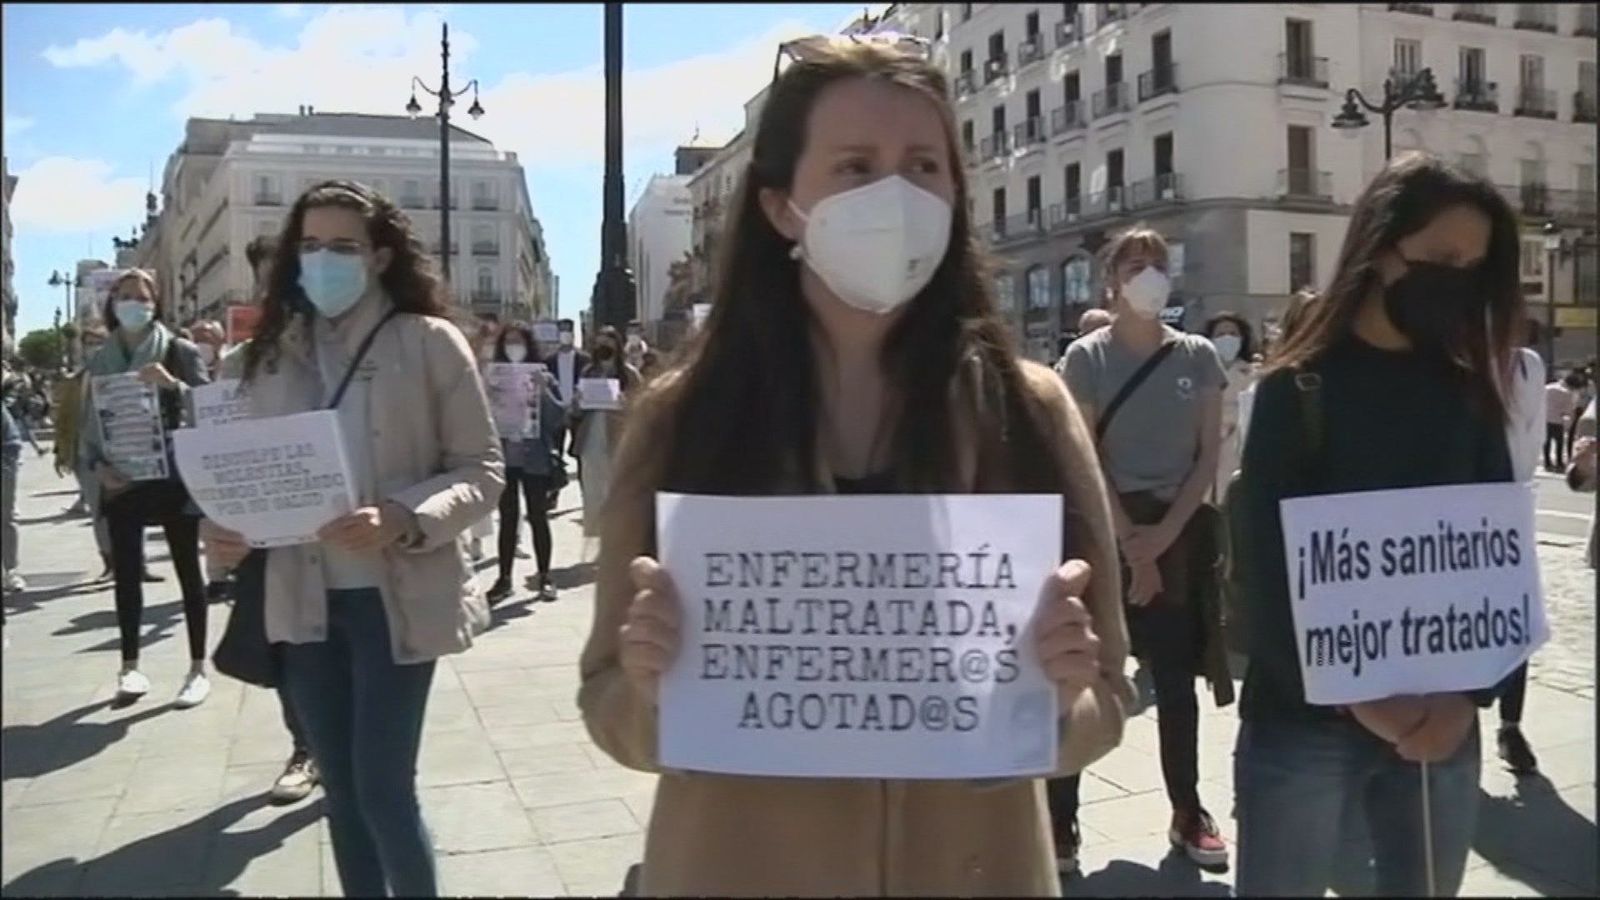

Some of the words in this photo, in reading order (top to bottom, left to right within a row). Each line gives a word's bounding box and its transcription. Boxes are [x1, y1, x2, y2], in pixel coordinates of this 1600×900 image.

[704, 543, 1018, 590] ENFERMERÍA
[1298, 527, 1371, 600] ¡Más
[1380, 517, 1521, 577] sanitarios
[702, 598, 1018, 645] MALTRATADA,
[1305, 609, 1393, 677] mejor
[1400, 593, 1531, 657] tratados!
[700, 643, 1021, 684] ENFERMER@S
[737, 692, 980, 732] AGOTAD@S
